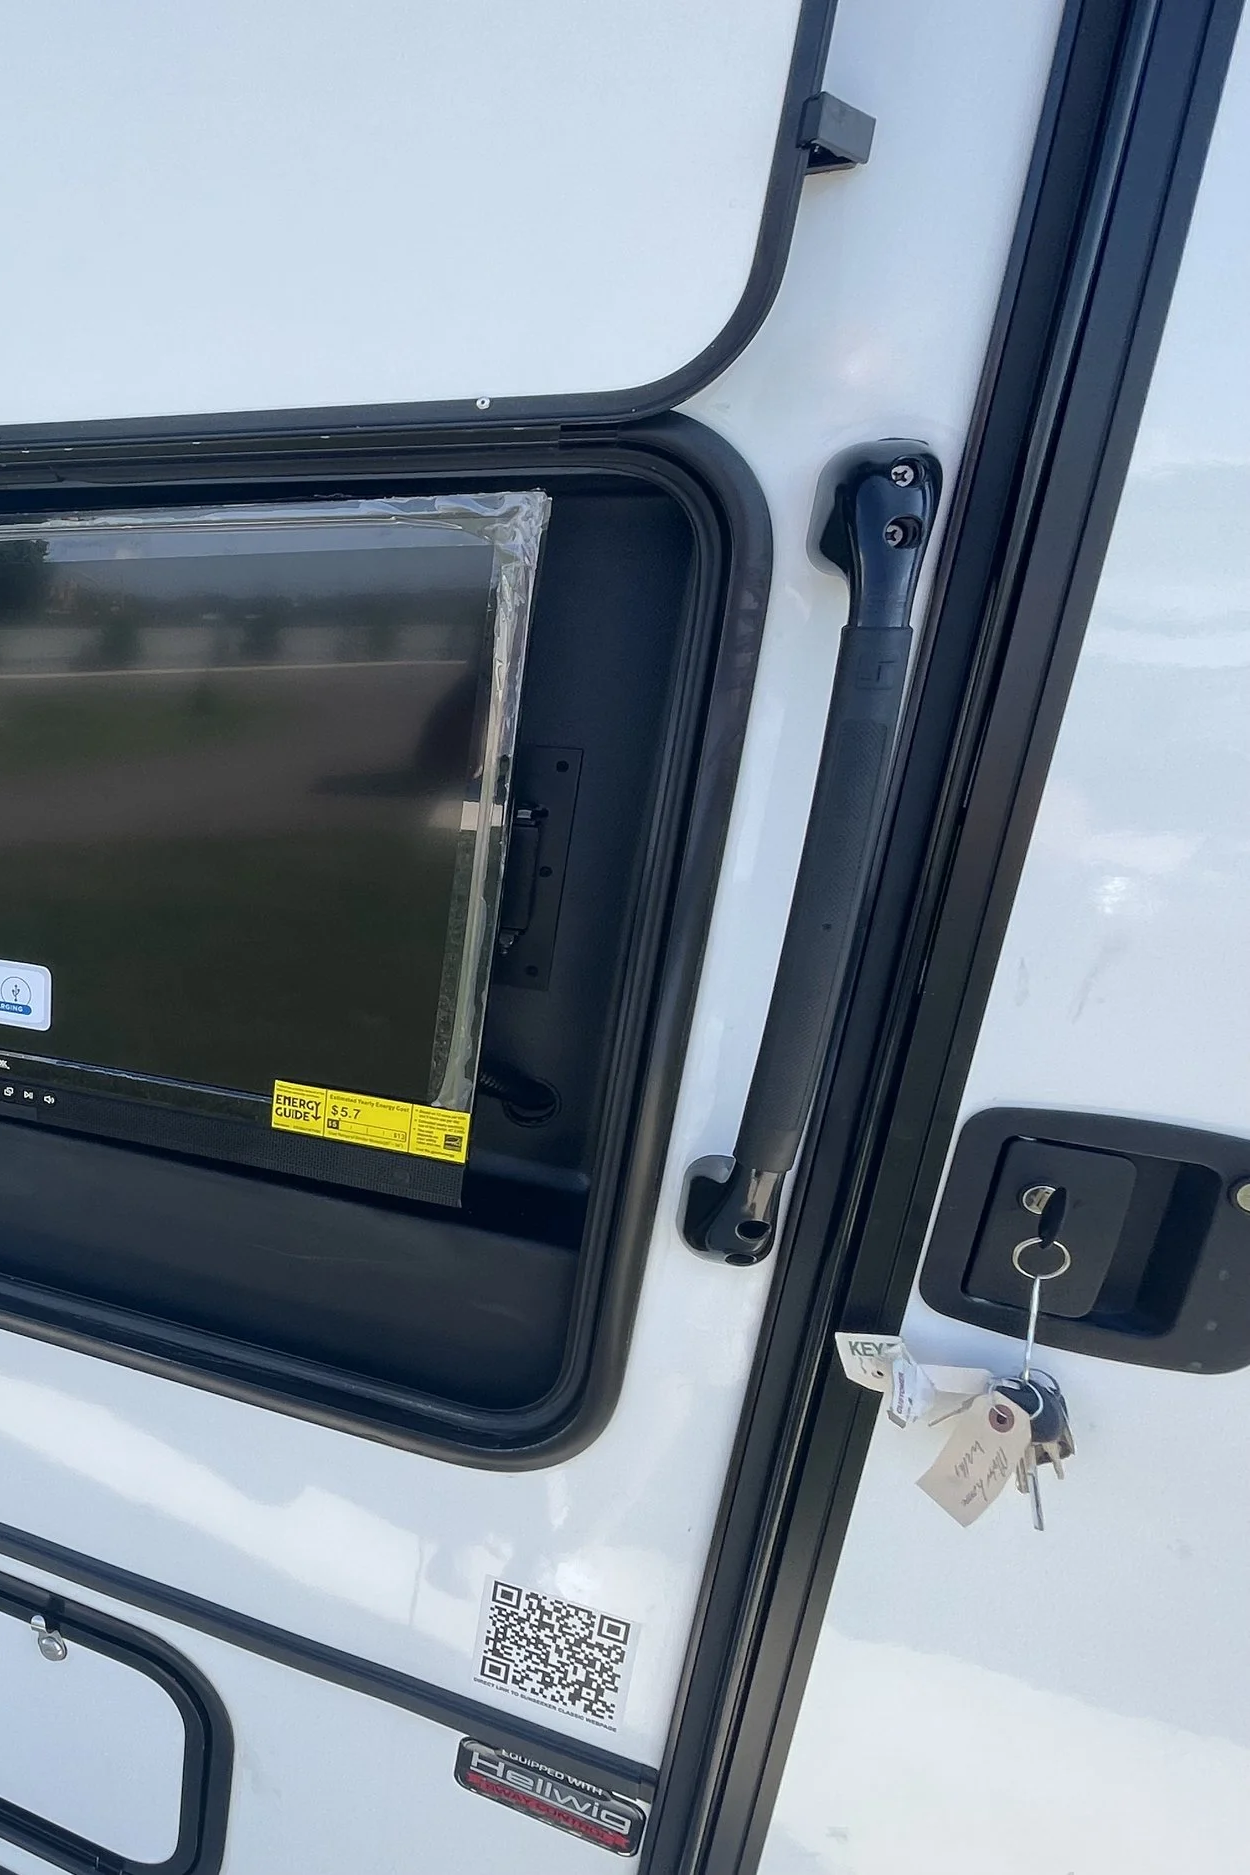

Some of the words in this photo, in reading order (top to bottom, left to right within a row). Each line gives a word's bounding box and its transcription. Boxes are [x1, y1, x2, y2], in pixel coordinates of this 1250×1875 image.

[275, 1094, 321, 1113] ENERGY
[275, 1107, 310, 1122] GUIDE
[330, 1094, 357, 1105] Estimated
[358, 1098, 375, 1108] Yearly
[375, 1101, 396, 1112] Energy
[396, 1105, 410, 1113] Cost
[896, 1372, 905, 1414] CUSTOMER
[473, 1677, 495, 1688] DIRECT
[496, 1684, 511, 1693] LINK
[520, 1692, 557, 1710] SUNSEEKER
[557, 1705, 584, 1721] CLASSIC
[585, 1717, 617, 1732] WEBPAGE
[469, 1750, 632, 1835] Hellwig
[502, 1749, 565, 1780] EQUIPPED
[567, 1776, 602, 1796] WITH
